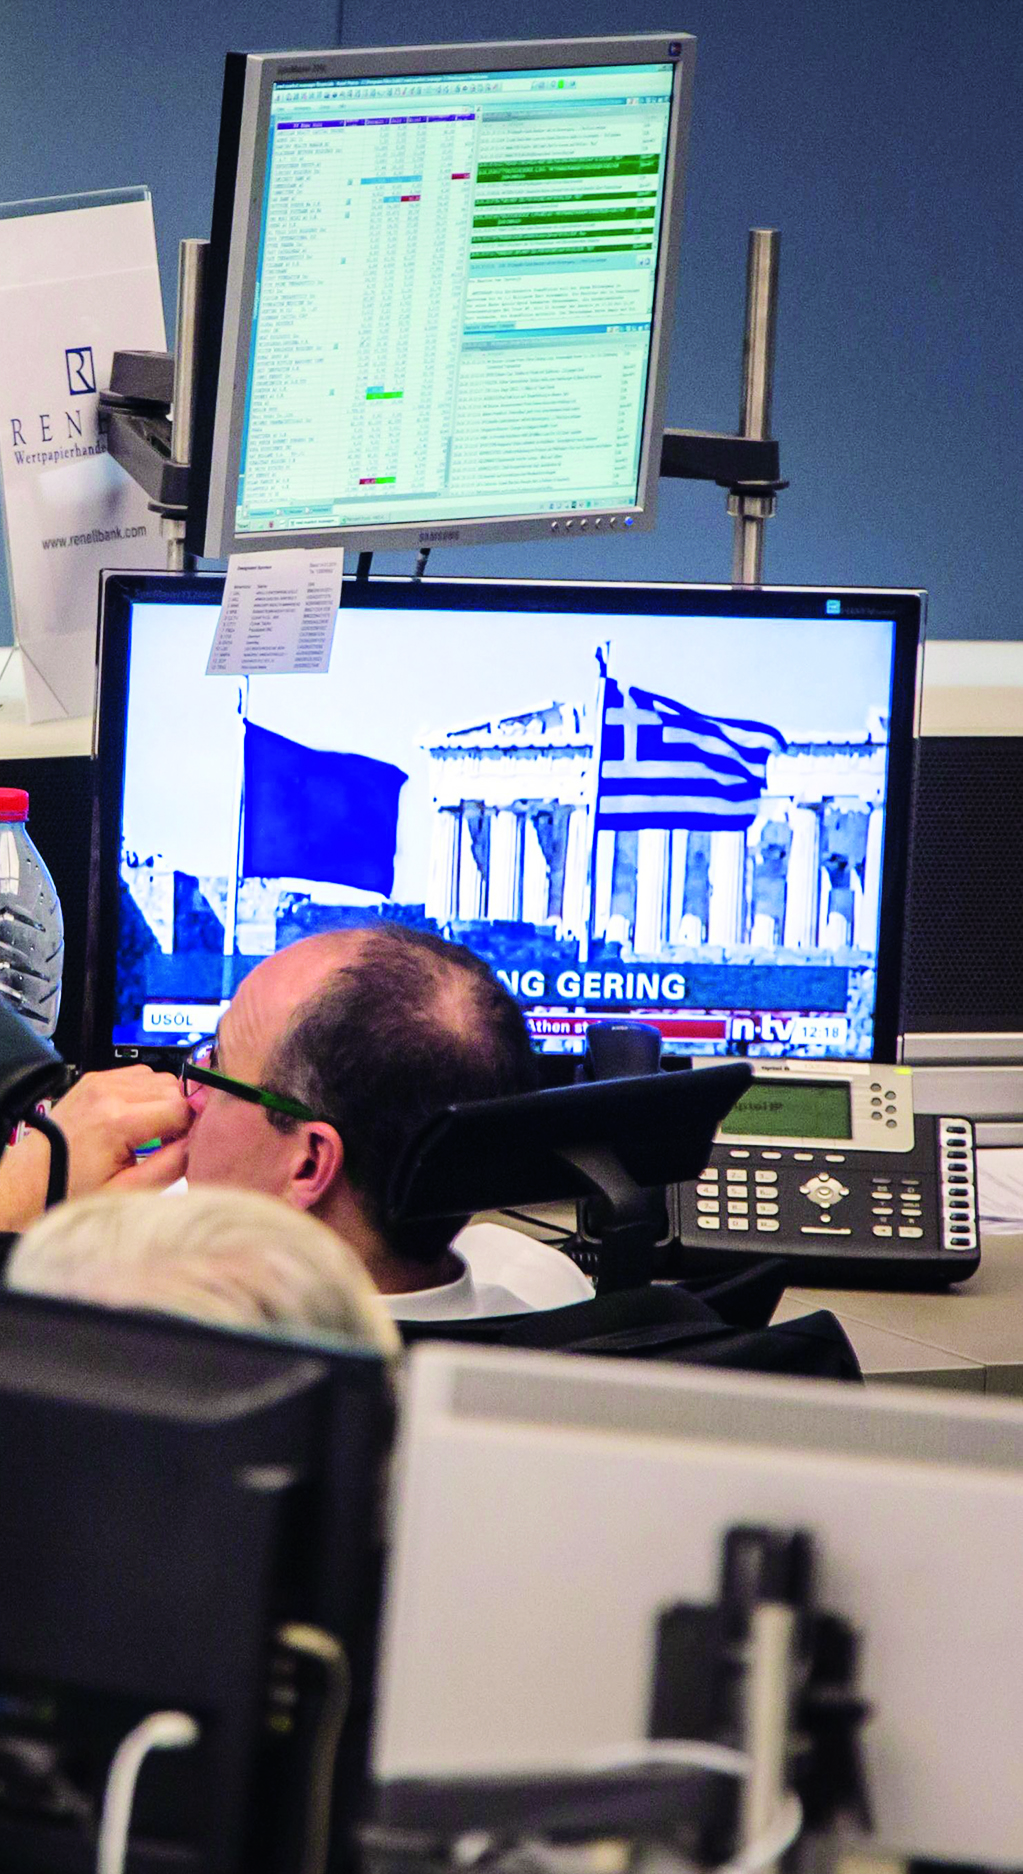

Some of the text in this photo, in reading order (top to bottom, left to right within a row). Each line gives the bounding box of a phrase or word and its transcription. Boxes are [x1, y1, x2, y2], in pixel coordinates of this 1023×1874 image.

[41, 526, 147, 550] www.renellbank.com
[556, 969, 687, 1001] GERING
[802, 1026, 840, 1039] 12:18
